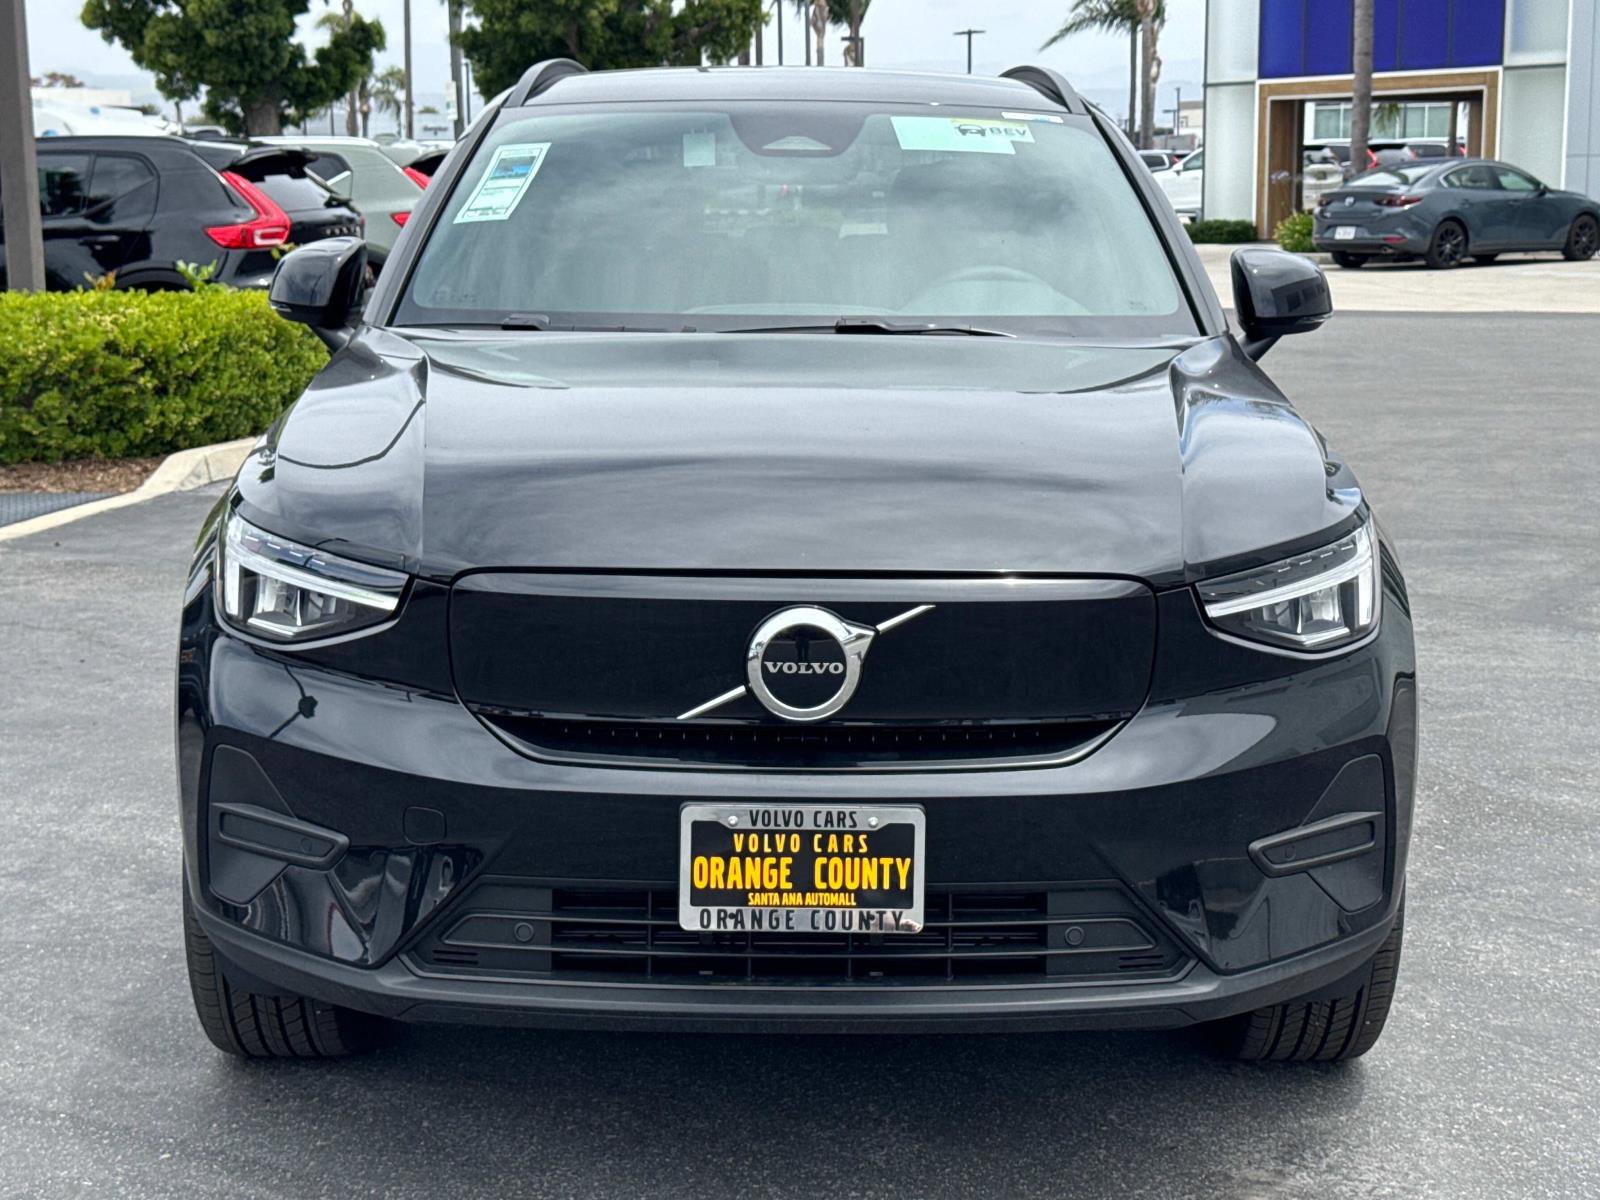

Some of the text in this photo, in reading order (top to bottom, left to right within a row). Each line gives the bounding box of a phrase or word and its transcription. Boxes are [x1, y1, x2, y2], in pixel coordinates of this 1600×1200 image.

[764, 661, 844, 674] VOLVO
[749, 809, 858, 828] VOLVO CARS
[733, 833, 868, 853] VOLVO CARS
[693, 856, 911, 890] ORANGE COUNTY
[748, 892, 857, 906] SANTA ANA AUTOMALL
[700, 908, 904, 932] ORANGE COUNTY
